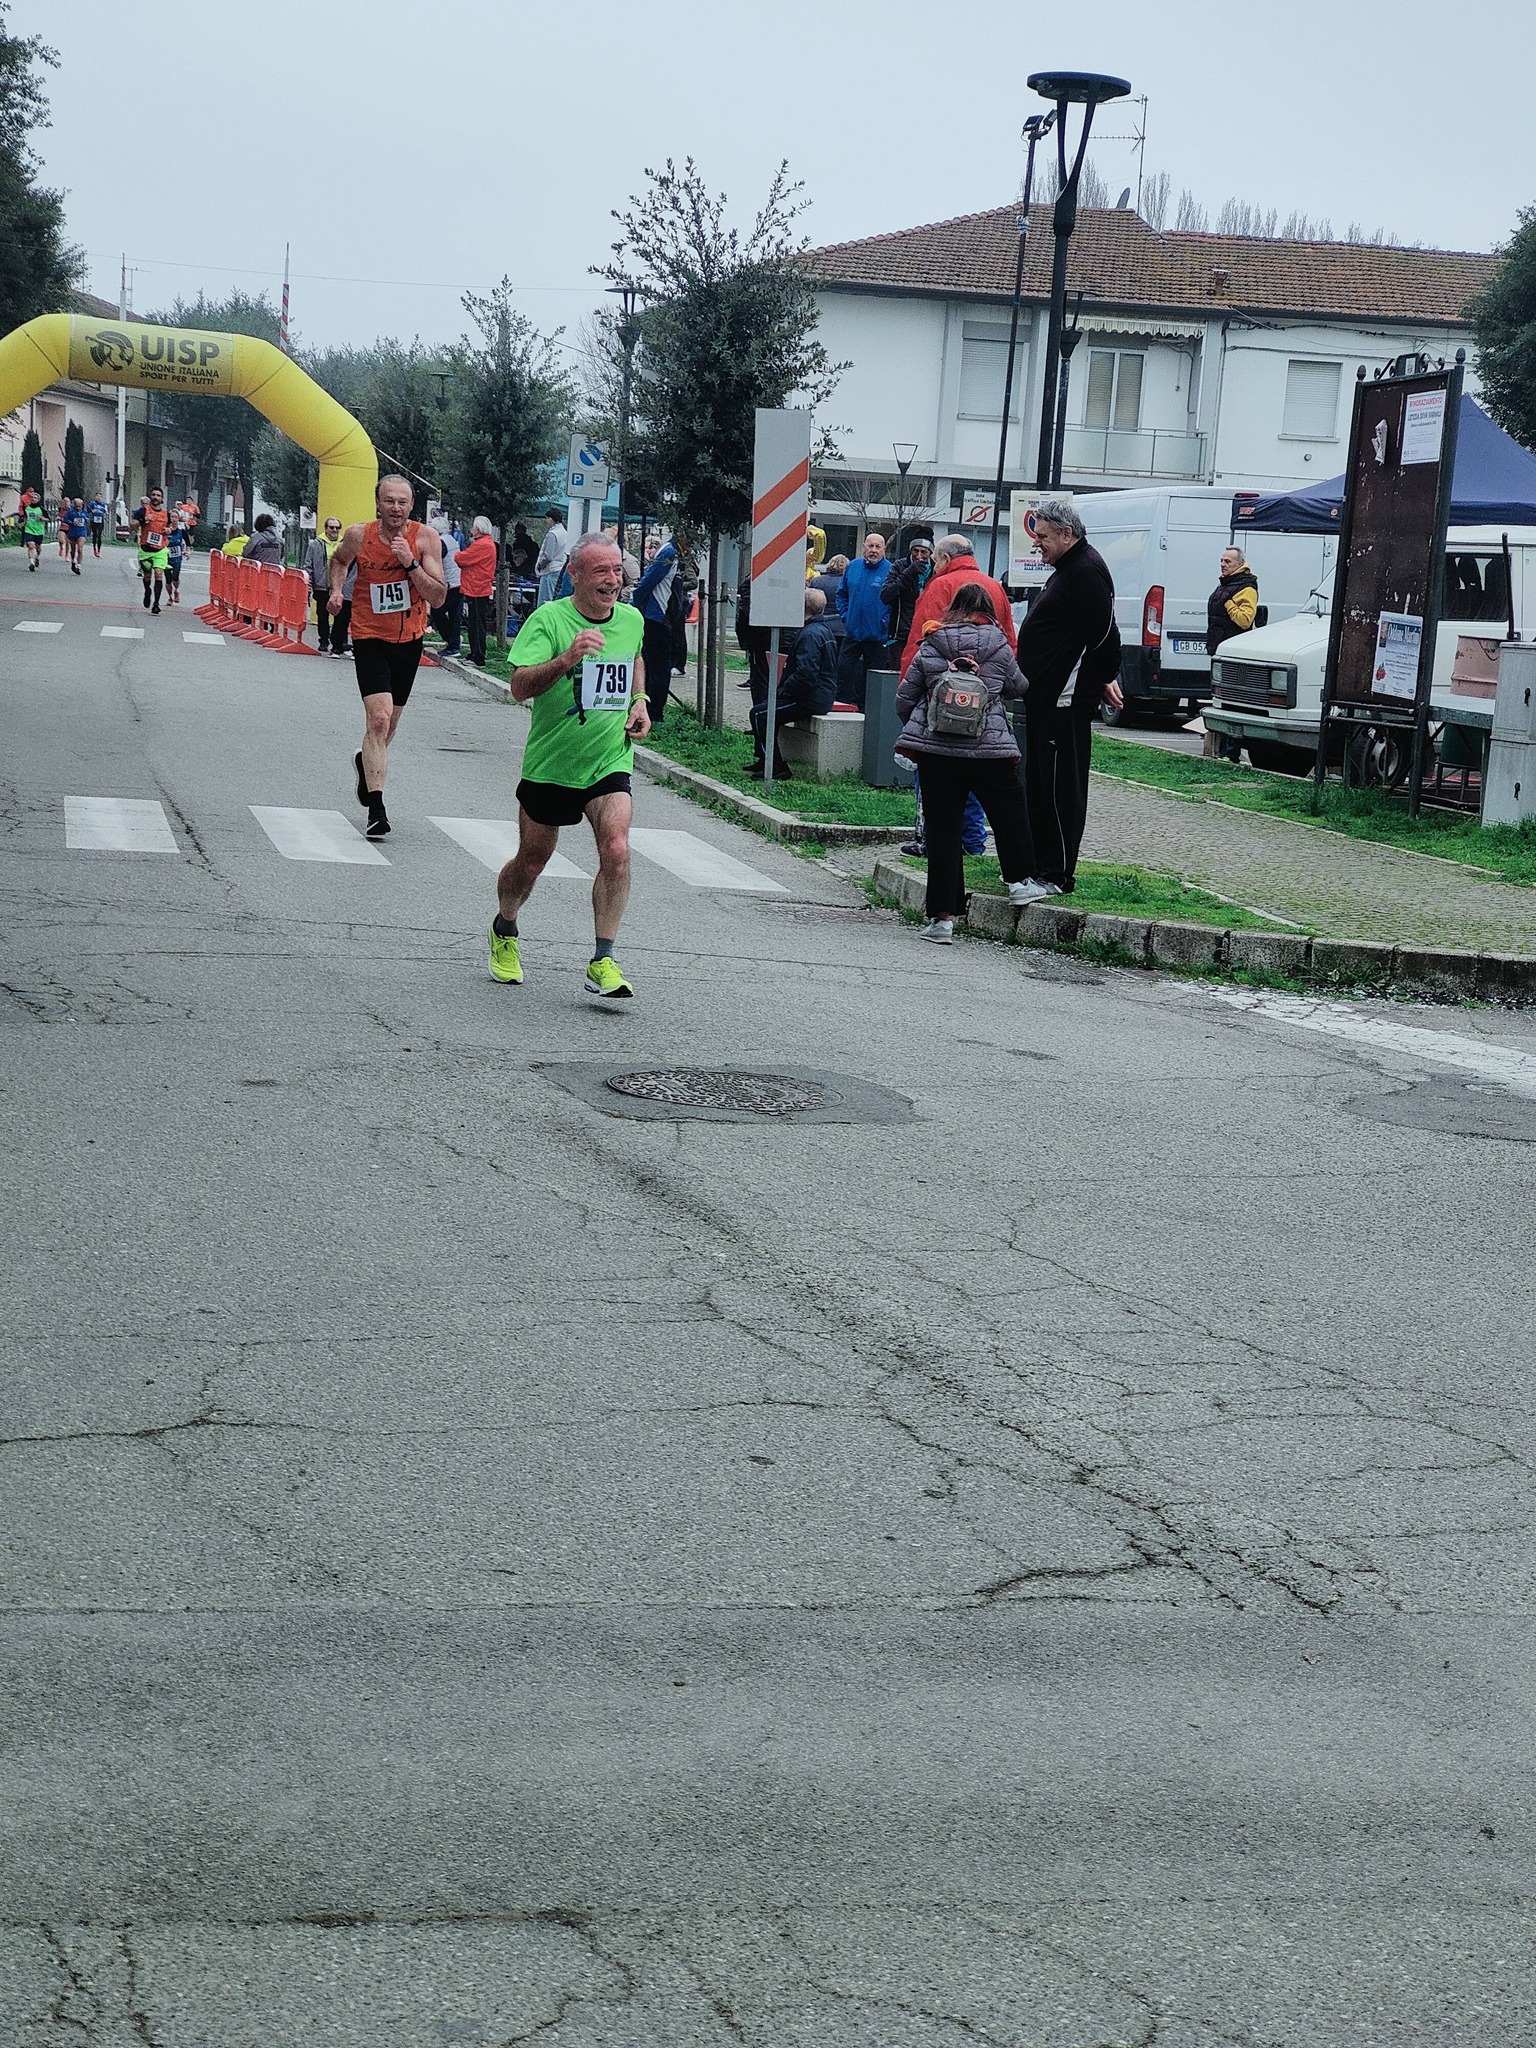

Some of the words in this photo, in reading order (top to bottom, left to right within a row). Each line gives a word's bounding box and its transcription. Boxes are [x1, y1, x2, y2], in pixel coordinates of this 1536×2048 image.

[140, 334, 220, 366] UISP
[139, 371, 168, 381] SPORT
[171, 375, 187, 383] PER
[191, 377, 214, 386] TUTTI
[140, 362, 176, 374] UNIONE
[179, 366, 220, 378] ITALIANA
[377, 582, 404, 604] 745
[595, 663, 627, 694] 739
